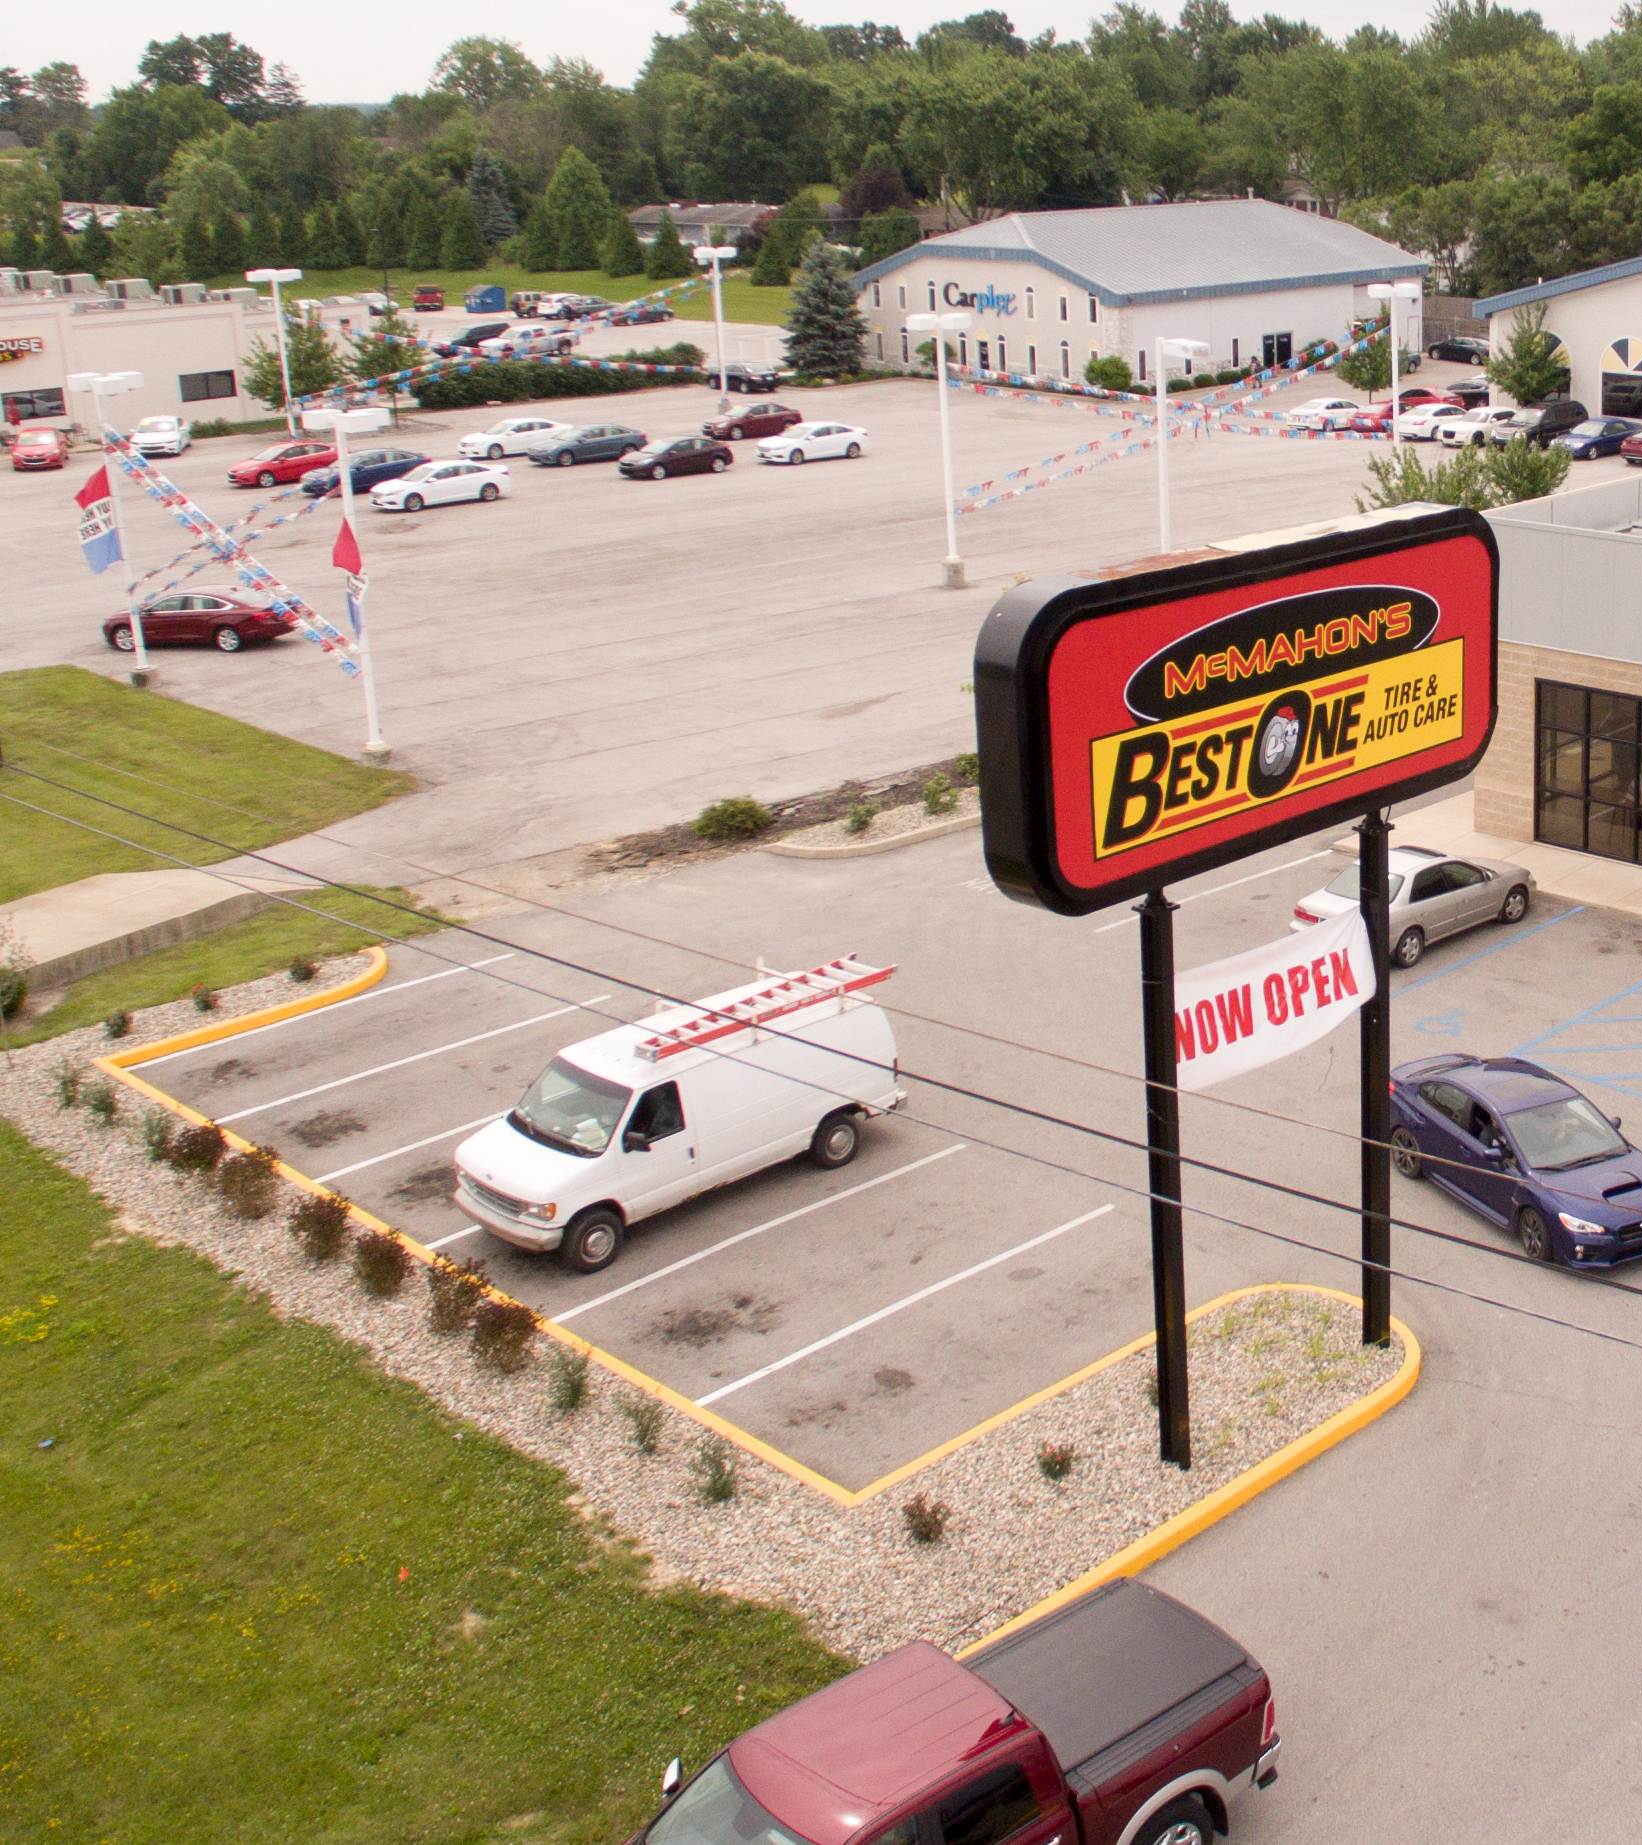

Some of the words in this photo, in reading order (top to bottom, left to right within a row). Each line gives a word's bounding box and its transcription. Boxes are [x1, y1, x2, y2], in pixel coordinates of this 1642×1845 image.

[943, 281, 1017, 317] Carplex
[1165, 602, 1411, 698] McMAHON'S
[1384, 677, 1423, 711] TIRE
[1425, 673, 1438, 698] &
[1363, 708, 1409, 745] AUTO
[1413, 693, 1458, 728] CARE
[1174, 983, 1254, 1064] NOW
[1263, 946, 1359, 1026] OPEN
